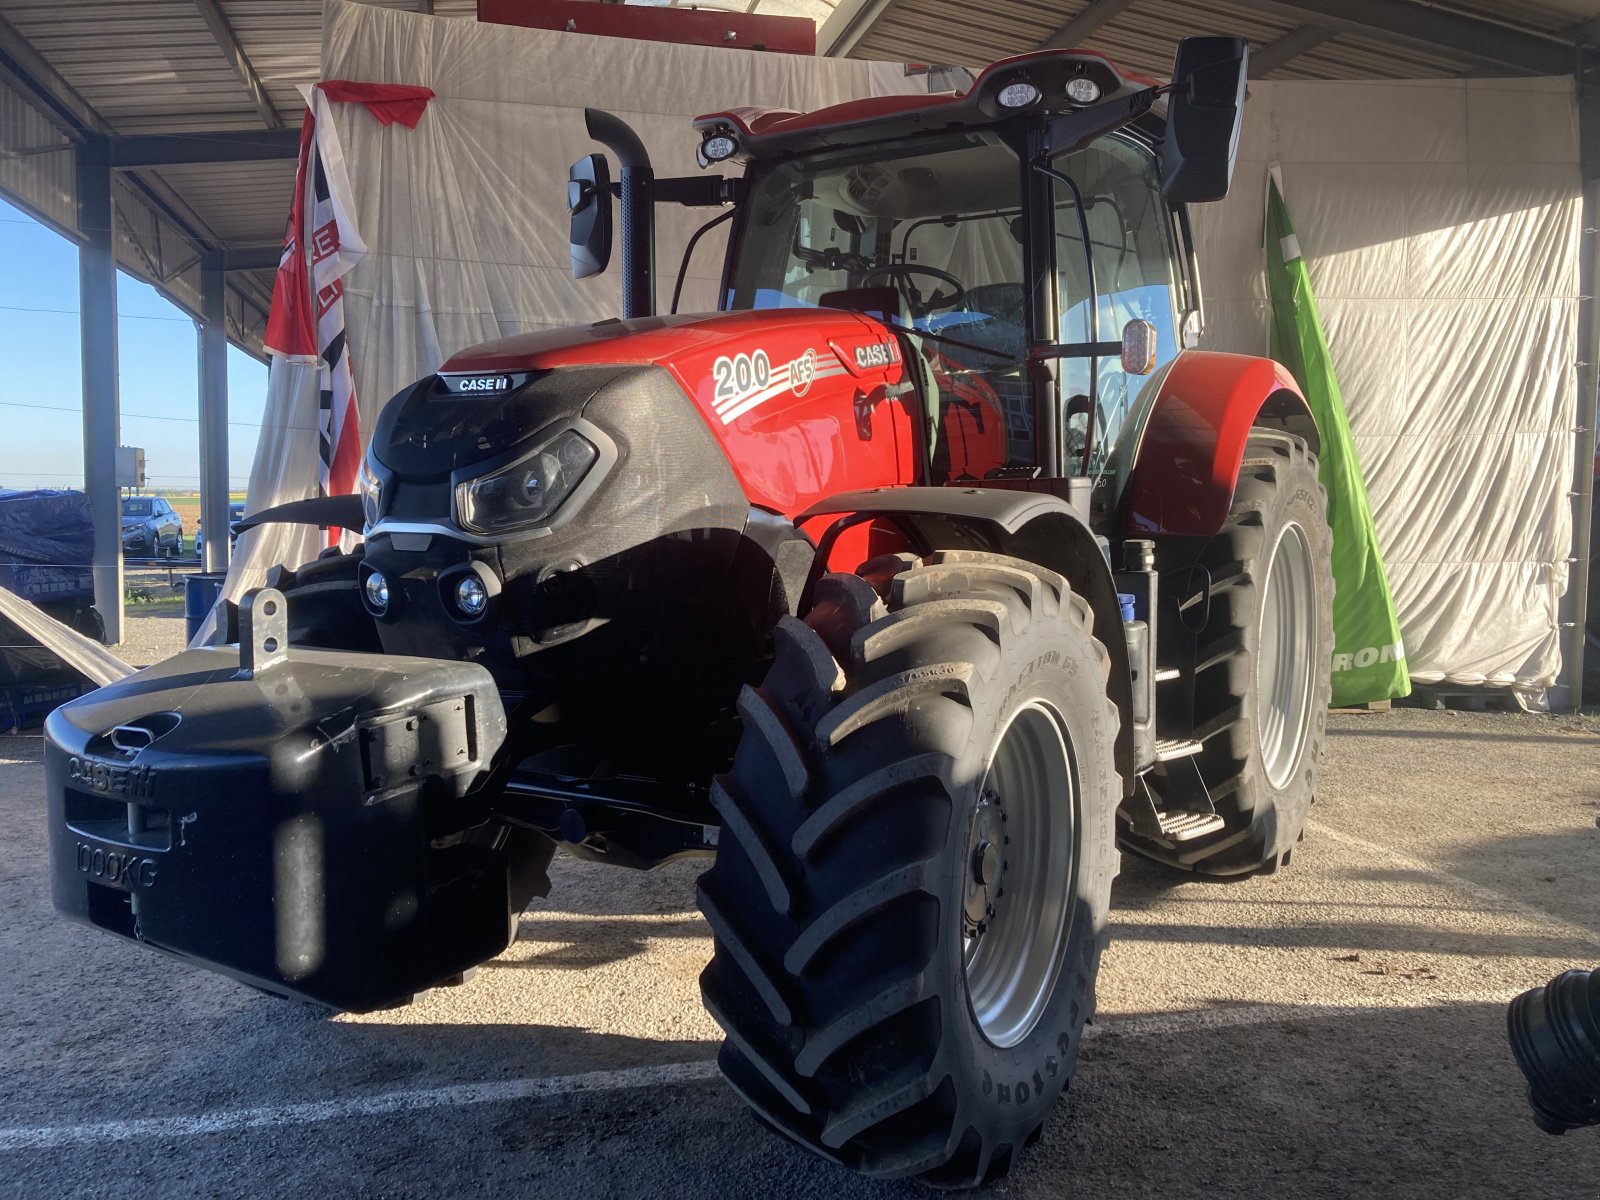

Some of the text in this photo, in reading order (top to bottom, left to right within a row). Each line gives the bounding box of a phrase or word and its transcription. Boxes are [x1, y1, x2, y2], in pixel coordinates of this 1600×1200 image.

[789, 354, 814, 385] AFS
[854, 342, 887, 368] CASE
[459, 379, 495, 391] CASE
[714, 349, 770, 398] 200
[69, 756, 128, 791] CASE
[76, 841, 159, 887] 1000KG
